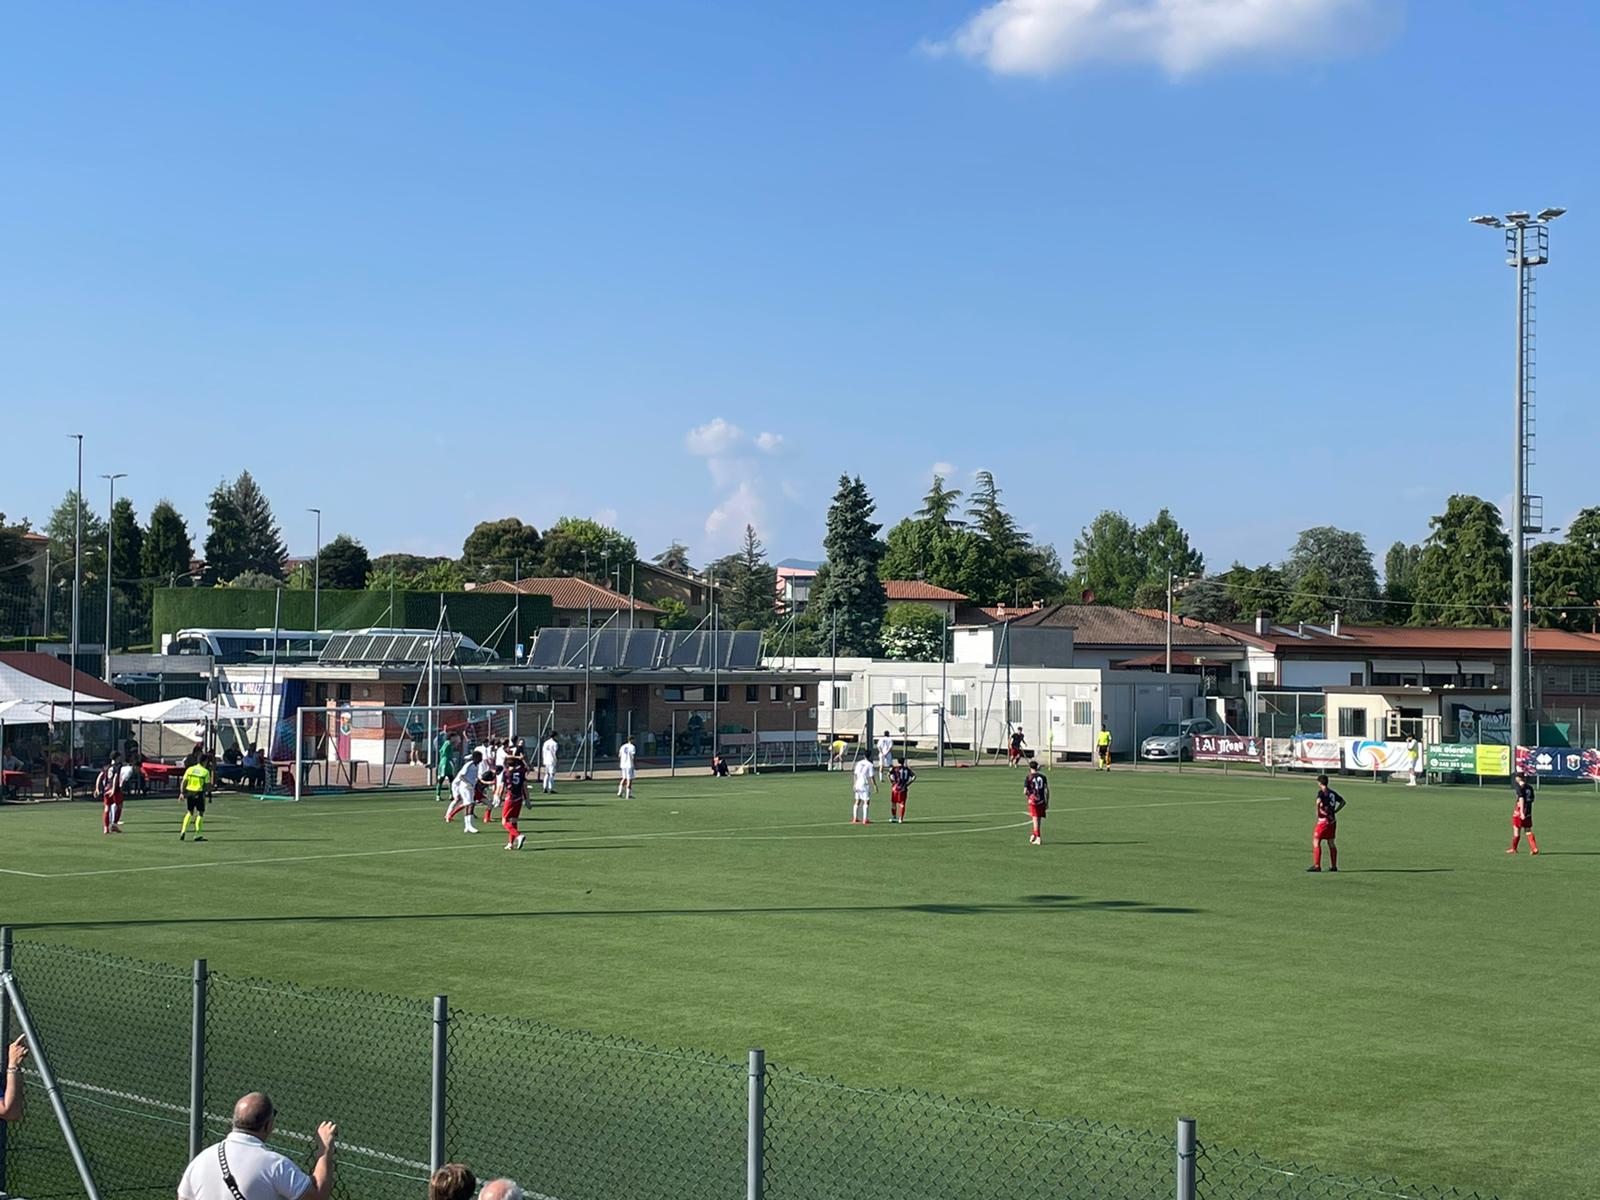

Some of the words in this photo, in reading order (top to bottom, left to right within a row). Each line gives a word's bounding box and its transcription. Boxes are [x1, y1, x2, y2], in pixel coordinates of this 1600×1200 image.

[1201, 737, 1216, 752] Al
[512, 772, 520, 785] 5
[899, 768, 909, 780] 11
[1032, 776, 1044, 790] 10
[1329, 792, 1336, 807] 3
